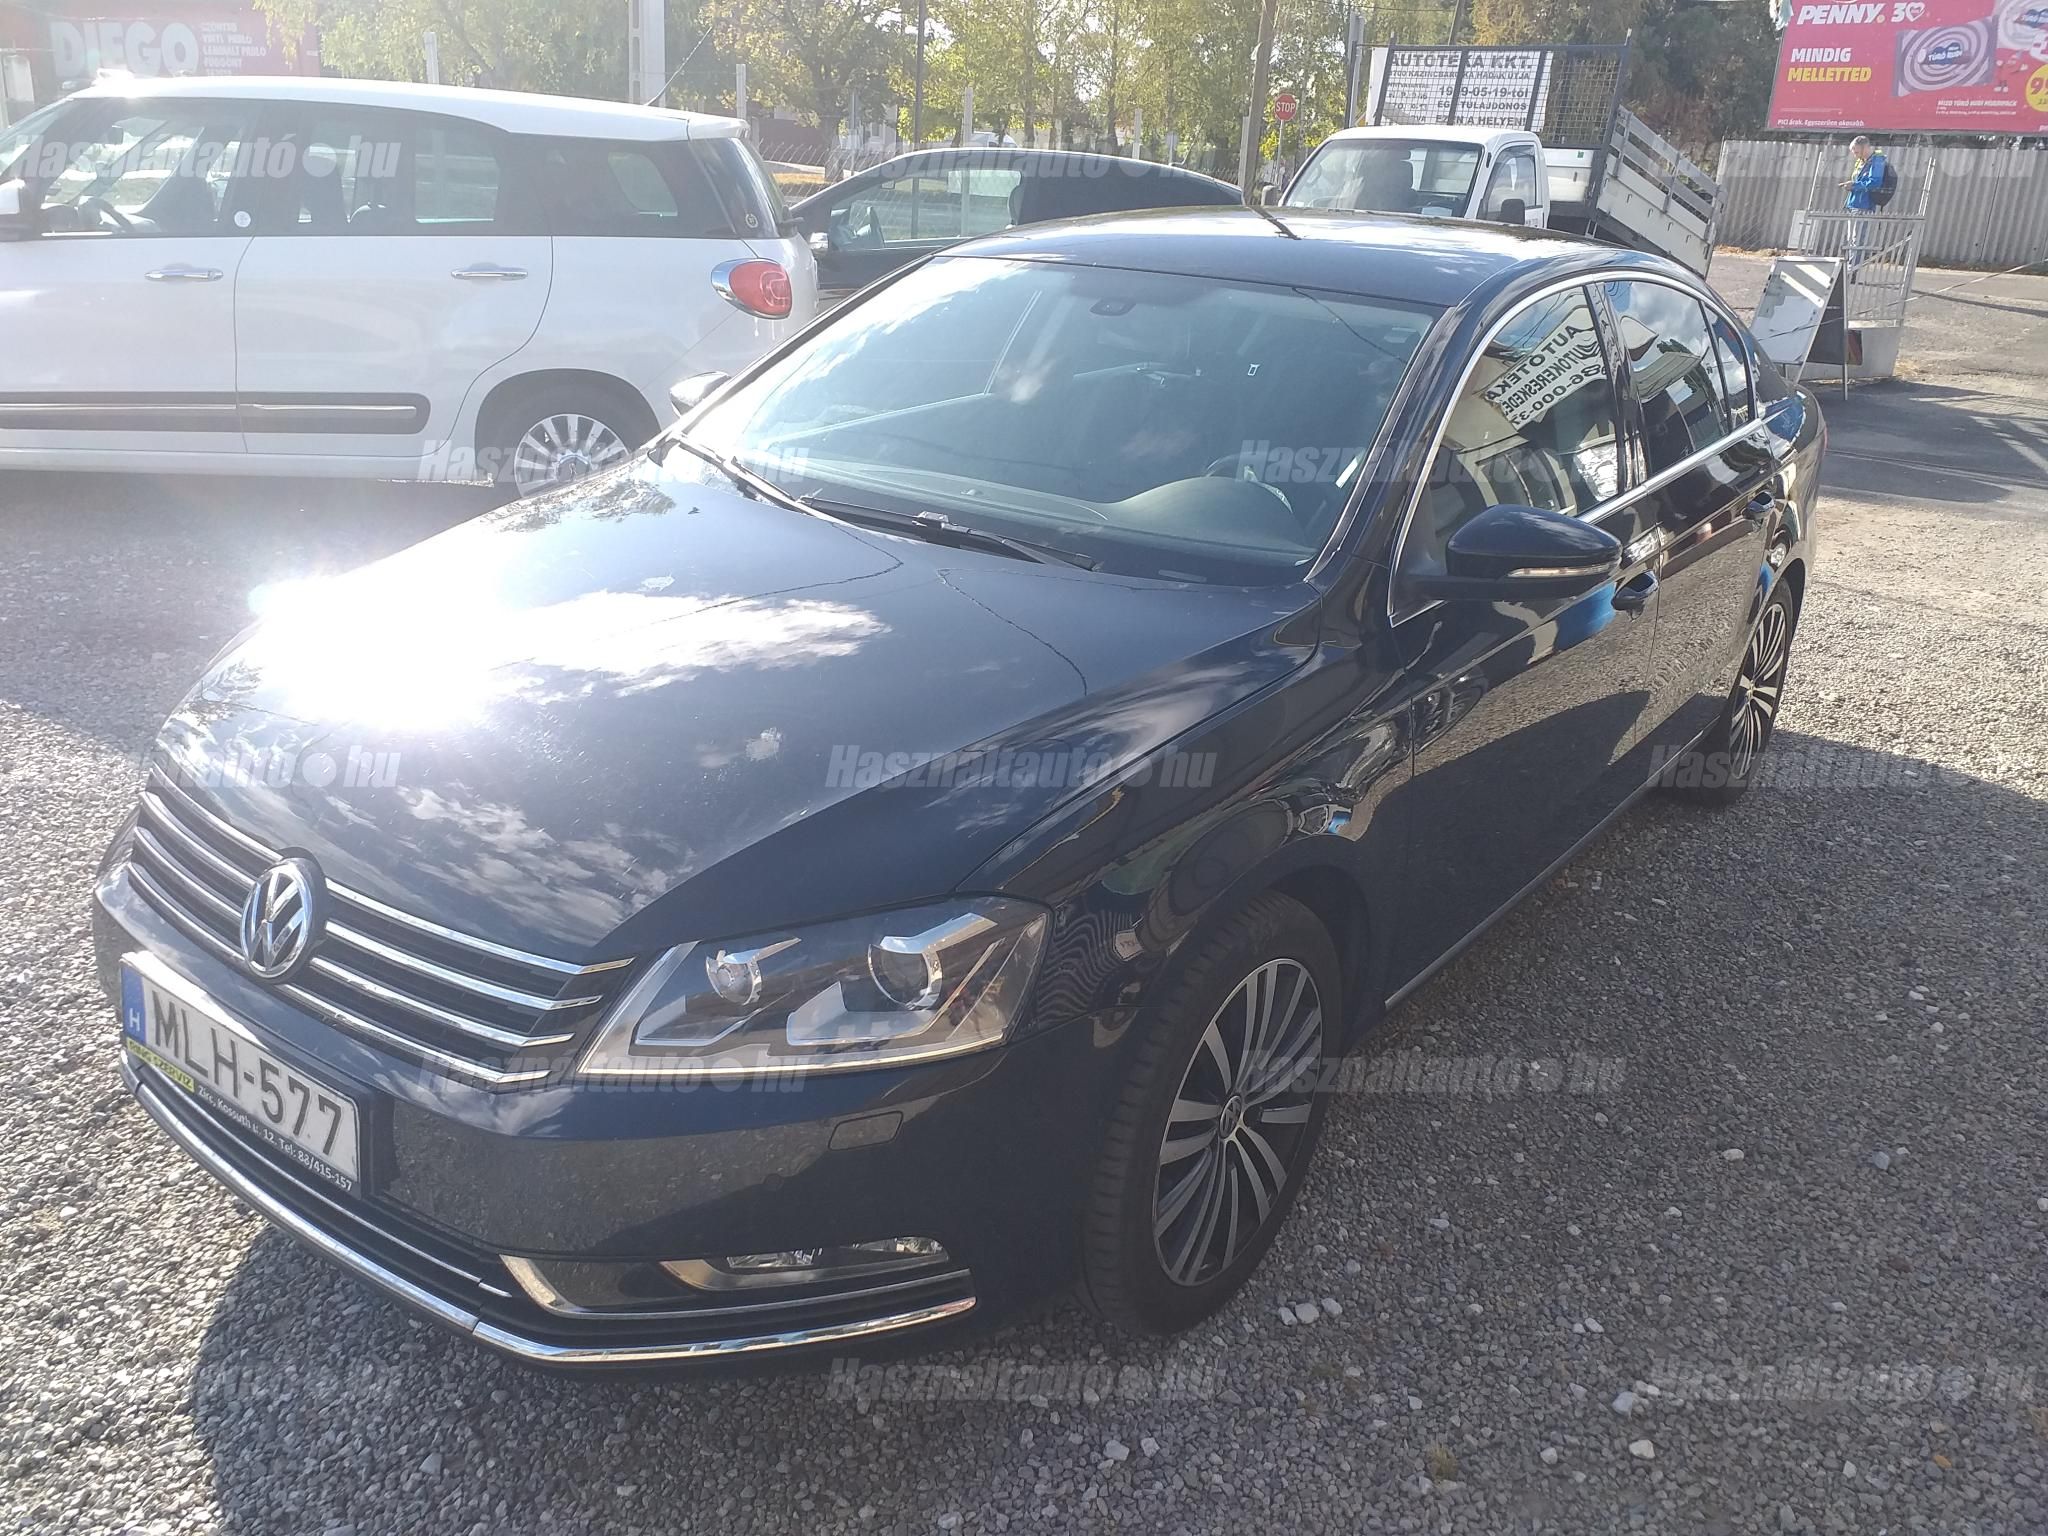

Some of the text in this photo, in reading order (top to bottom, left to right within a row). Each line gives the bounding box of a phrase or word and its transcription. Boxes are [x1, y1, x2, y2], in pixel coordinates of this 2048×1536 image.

[50, 21, 199, 78] DIEGO
[1791, 48, 1852, 62] MINDIG
[1787, 67, 1872, 82] MELLETTED
[1439, 85, 1529, 98] 199-05-19-től
[1276, 101, 1296, 112] STOP
[1461, 101, 1527, 110] TULAJDONOS
[1436, 115, 1463, 124] EZN
[128, 1008, 141, 1032] H
[152, 990, 342, 1155] MLH-577
